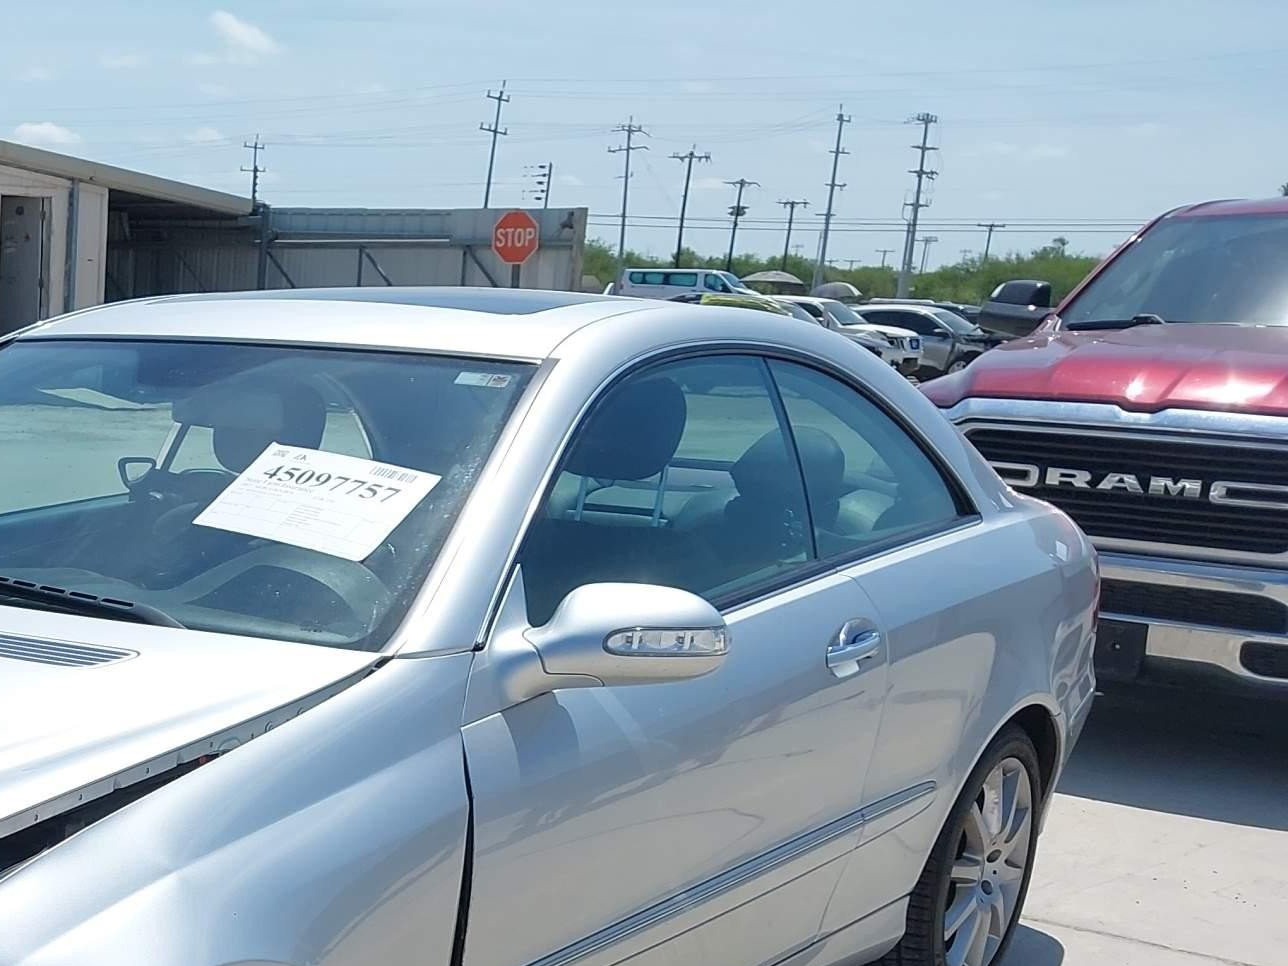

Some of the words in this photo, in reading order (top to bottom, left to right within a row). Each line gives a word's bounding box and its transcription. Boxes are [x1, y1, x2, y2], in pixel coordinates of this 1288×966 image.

[496, 228, 535, 247] STOP
[263, 465, 401, 503] 45097757
[1045, 467, 1202, 499] RAM
